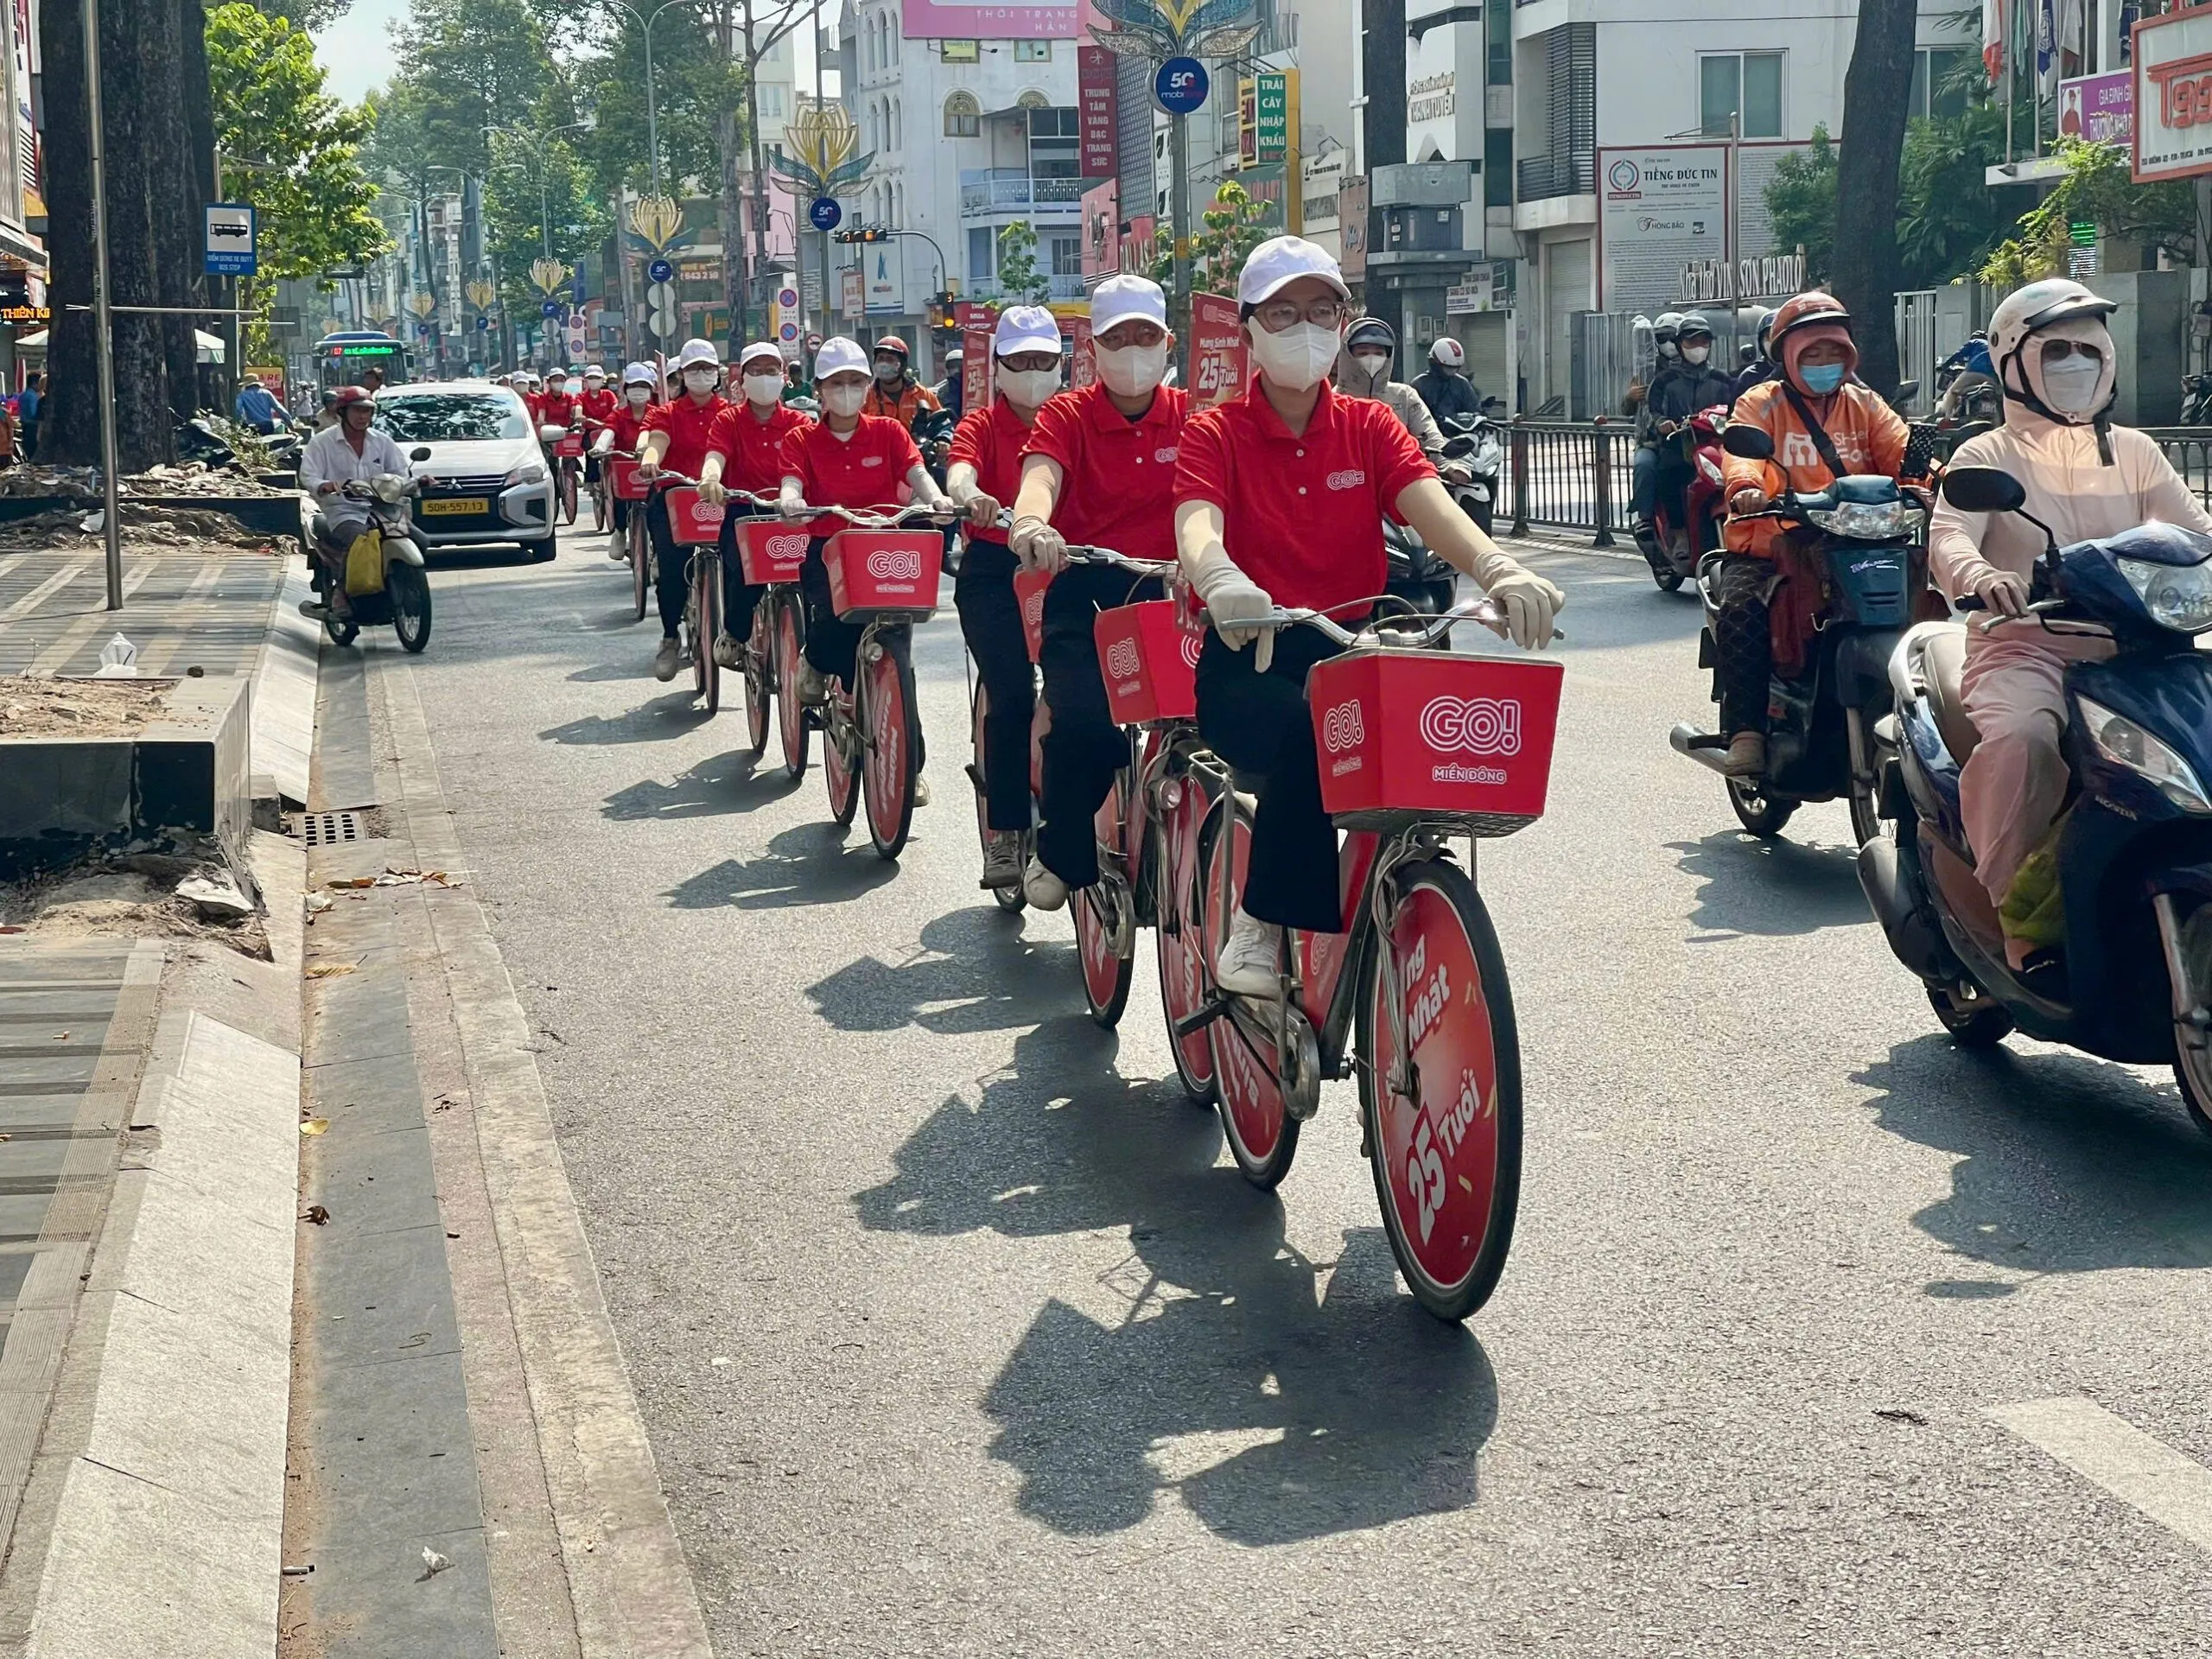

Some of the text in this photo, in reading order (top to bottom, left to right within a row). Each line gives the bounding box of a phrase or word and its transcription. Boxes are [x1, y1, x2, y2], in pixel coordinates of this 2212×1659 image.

[1025, 10, 1077, 18] TRANG
[1170, 72, 1196, 88] 5G
[1084, 88, 1110, 98] TRUNG
[1090, 102, 1107, 111] TÂM
[1262, 97, 1281, 108] CÂY
[1259, 115, 1285, 129] NHẬP
[1090, 130, 1107, 141] BẠC
[1086, 143, 1112, 153] TRANG
[1677, 168, 1698, 180] ĐỨC
[1700, 168, 1718, 179] TIN
[1672, 219, 1685, 229] BÁO
[1, 305, 35, 319] THIÊN
[1198, 357, 1220, 389] 25
[868, 550, 921, 579] GO!
[1107, 637, 1141, 679] GO!
[1324, 699, 1364, 753] GO!
[1421, 696, 1522, 756] GO!
[1467, 766, 1507, 784] ĐÔNG
[1408, 962, 1451, 1052] Nhật
[1408, 1068, 1481, 1247] 25 Tuổi
